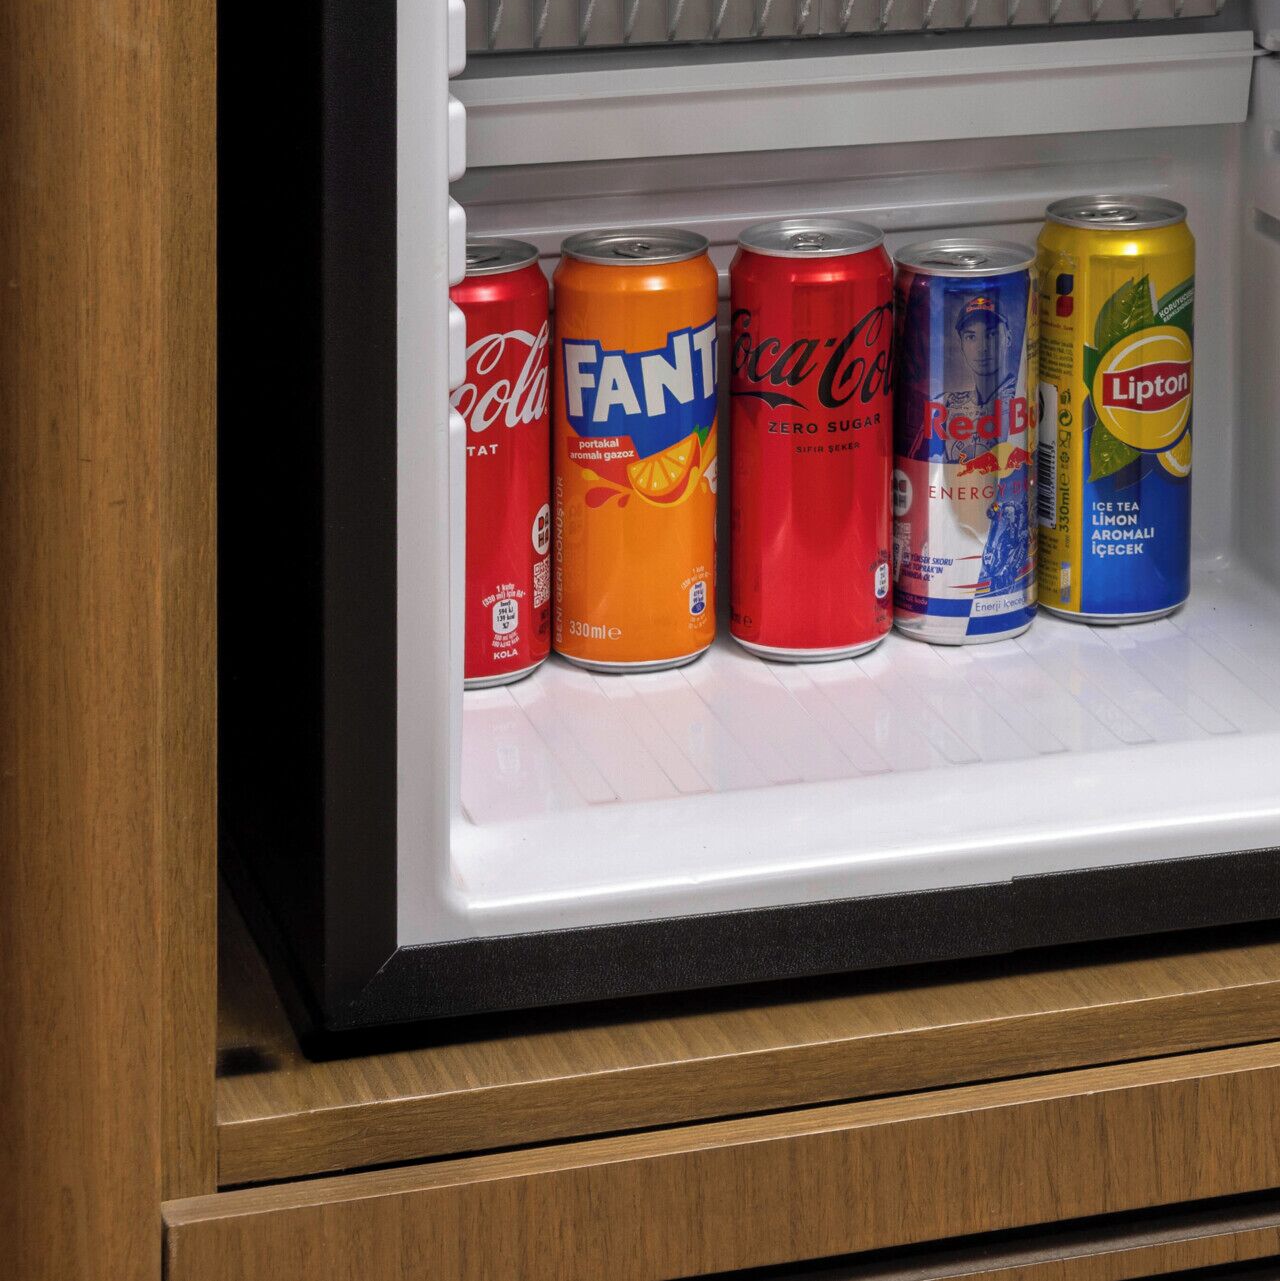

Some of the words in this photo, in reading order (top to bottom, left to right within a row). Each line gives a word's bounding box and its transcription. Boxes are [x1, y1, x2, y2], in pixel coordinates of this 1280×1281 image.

[565, 322, 718, 422] FANT
[1112, 372, 1188, 404] Lipton
[768, 421, 818, 434] ZERO
[827, 412, 881, 433] SUGAR
[924, 400, 1002, 440] Red
[467, 443, 499, 456] TAT
[578, 438, 620, 449] portakal
[828, 442, 861, 454] ŞEKER
[570, 450, 603, 460] aromalı
[604, 450, 635, 462] gazoz
[929, 484, 1006, 499] ENERGY
[1092, 501, 1113, 512] ICE
[1117, 501, 1140, 511] TEA
[1091, 512, 1138, 526] LİMON
[1091, 527, 1155, 541] AROMALI
[1091, 542, 1144, 558] İÇECEK
[976, 601, 1001, 611] Enerji
[493, 648, 518, 660] KOLA
